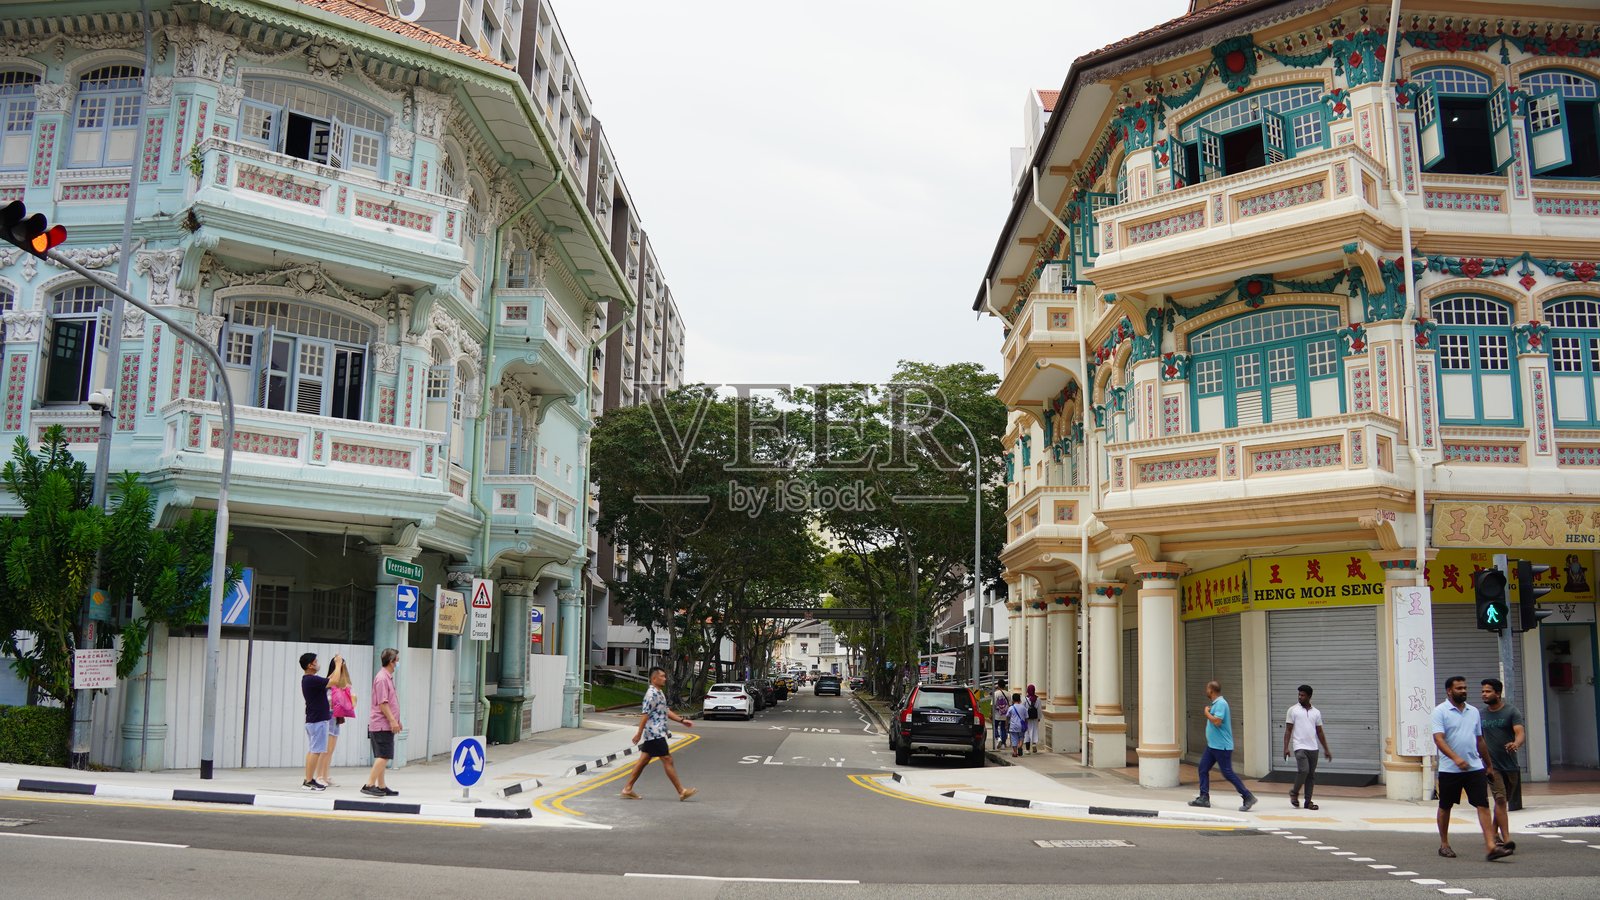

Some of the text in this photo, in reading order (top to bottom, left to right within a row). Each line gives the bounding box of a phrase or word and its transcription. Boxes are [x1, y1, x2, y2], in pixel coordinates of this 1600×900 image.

[1445, 505, 1554, 546] 王茂成
[1565, 534, 1595, 544] HENG
[387, 560, 421, 578] Veerasamy Rd
[1268, 557, 1367, 584] 王茂成
[1188, 578, 1213, 612] 王茂成
[1253, 582, 1384, 601] HENG MOH SENG
[397, 610, 416, 619] ONE WAY
[475, 611, 487, 619] Raised
[475, 620, 486, 628] Zebra
[472, 630, 489, 639] Crossing
[1408, 592, 1431, 715] 王茂成
[768, 725, 841, 733] X-ING
[738, 755, 846, 768] SL
